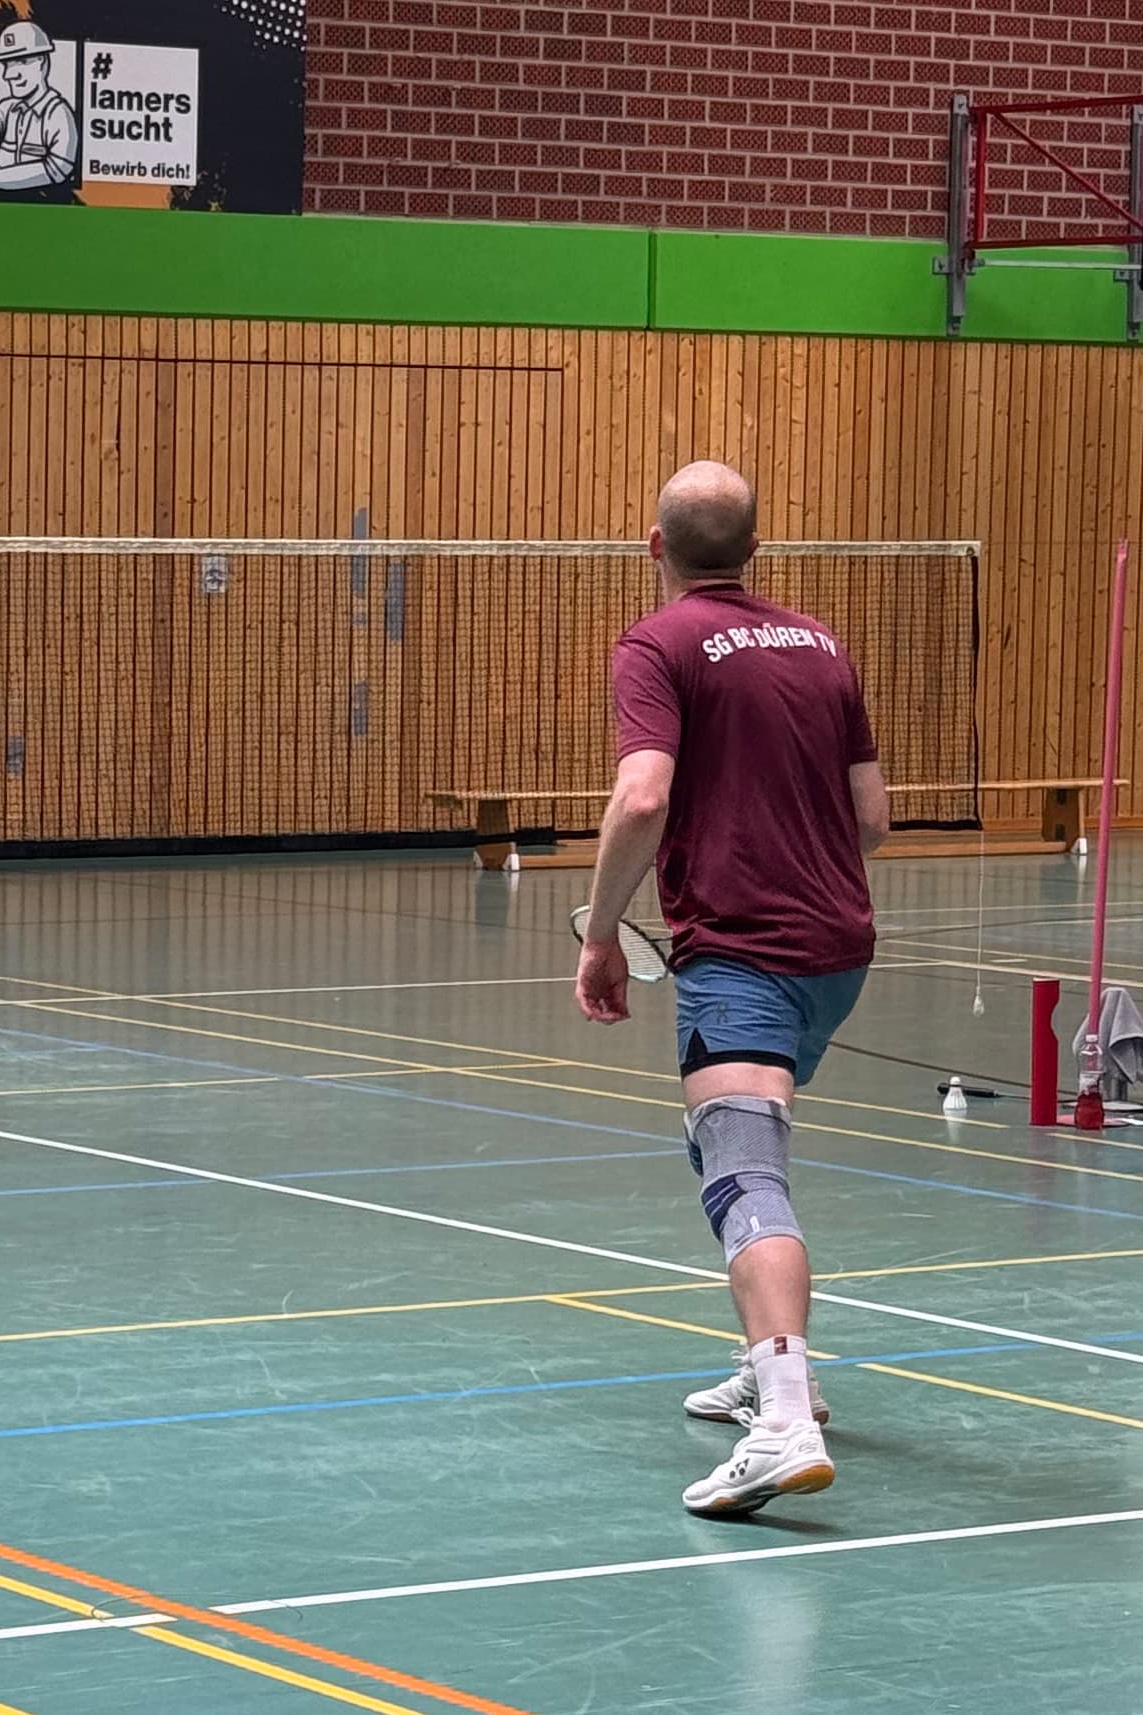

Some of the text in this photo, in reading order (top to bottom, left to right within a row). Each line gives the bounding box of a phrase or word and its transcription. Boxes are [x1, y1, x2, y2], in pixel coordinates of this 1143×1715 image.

[91, 52, 114, 80] #
[90, 81, 191, 114] lamers
[90, 114, 173, 142] sucht
[89, 159, 191, 179] Bewirb dich!
[702, 632, 734, 663] SG
[727, 627, 756, 650] BC
[752, 622, 818, 649] DÜREN
